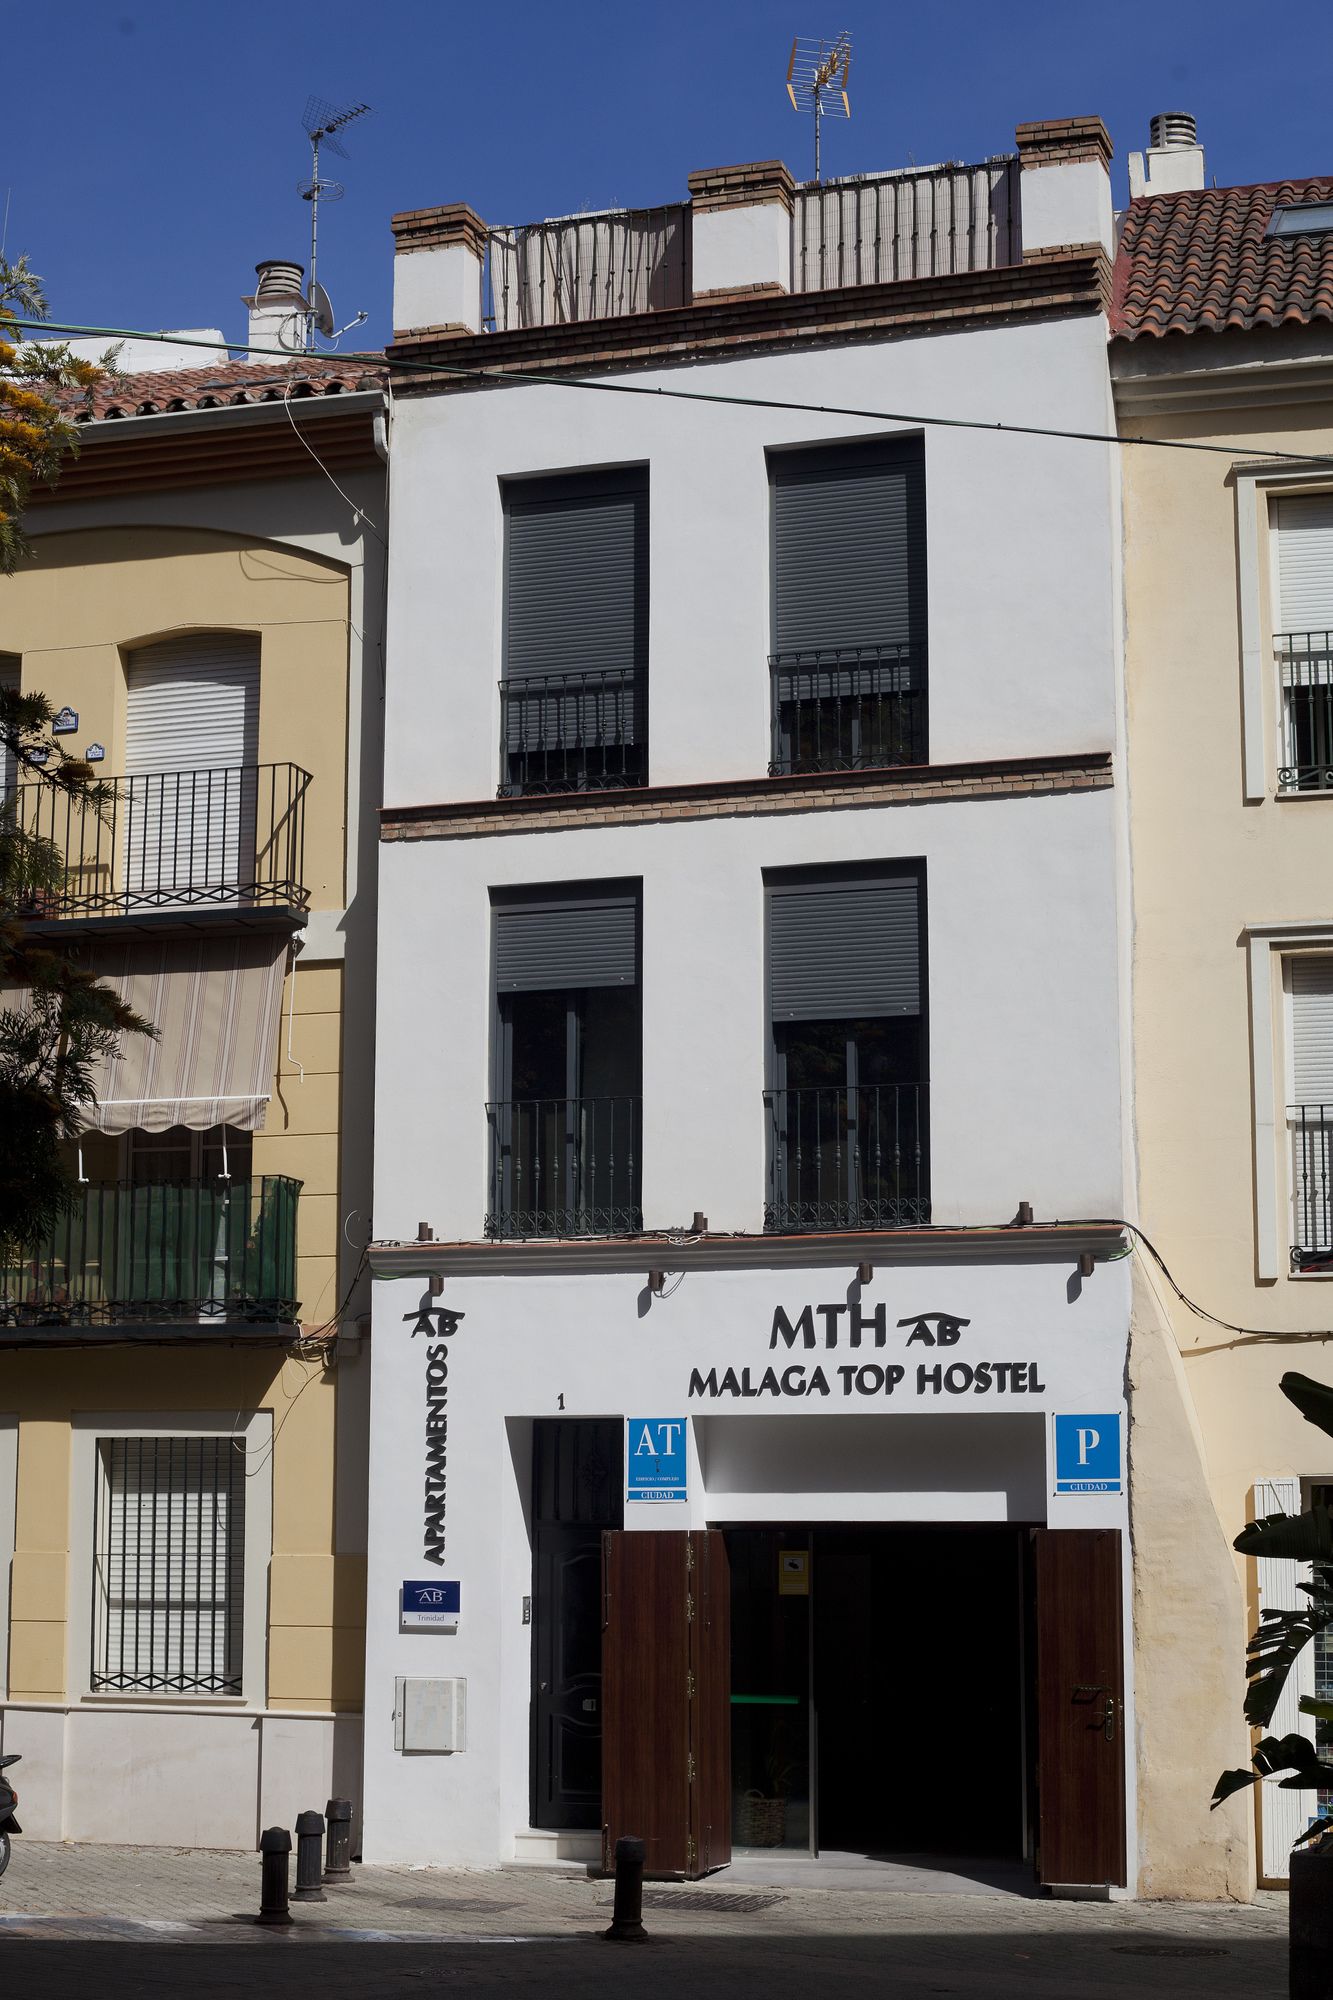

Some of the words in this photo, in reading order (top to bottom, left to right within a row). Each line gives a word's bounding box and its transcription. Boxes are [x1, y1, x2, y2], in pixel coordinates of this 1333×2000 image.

[769, 1303, 887, 1350] MTH
[688, 1364, 831, 1398] MALAGA
[837, 1363, 905, 1397] TOP
[916, 1361, 1046, 1395] HOSTEL
[557, 1392, 566, 1411] 1
[634, 1423, 681, 1456] AT
[1075, 1428, 1100, 1465] P
[423, 1343, 448, 1567] APARTAMENTOS
[641, 1491, 674, 1499] CIUDAD
[1070, 1483, 1108, 1491] CIUDAD
[417, 1590, 445, 1602] AB
[417, 1614, 445, 1622] Trinidad
